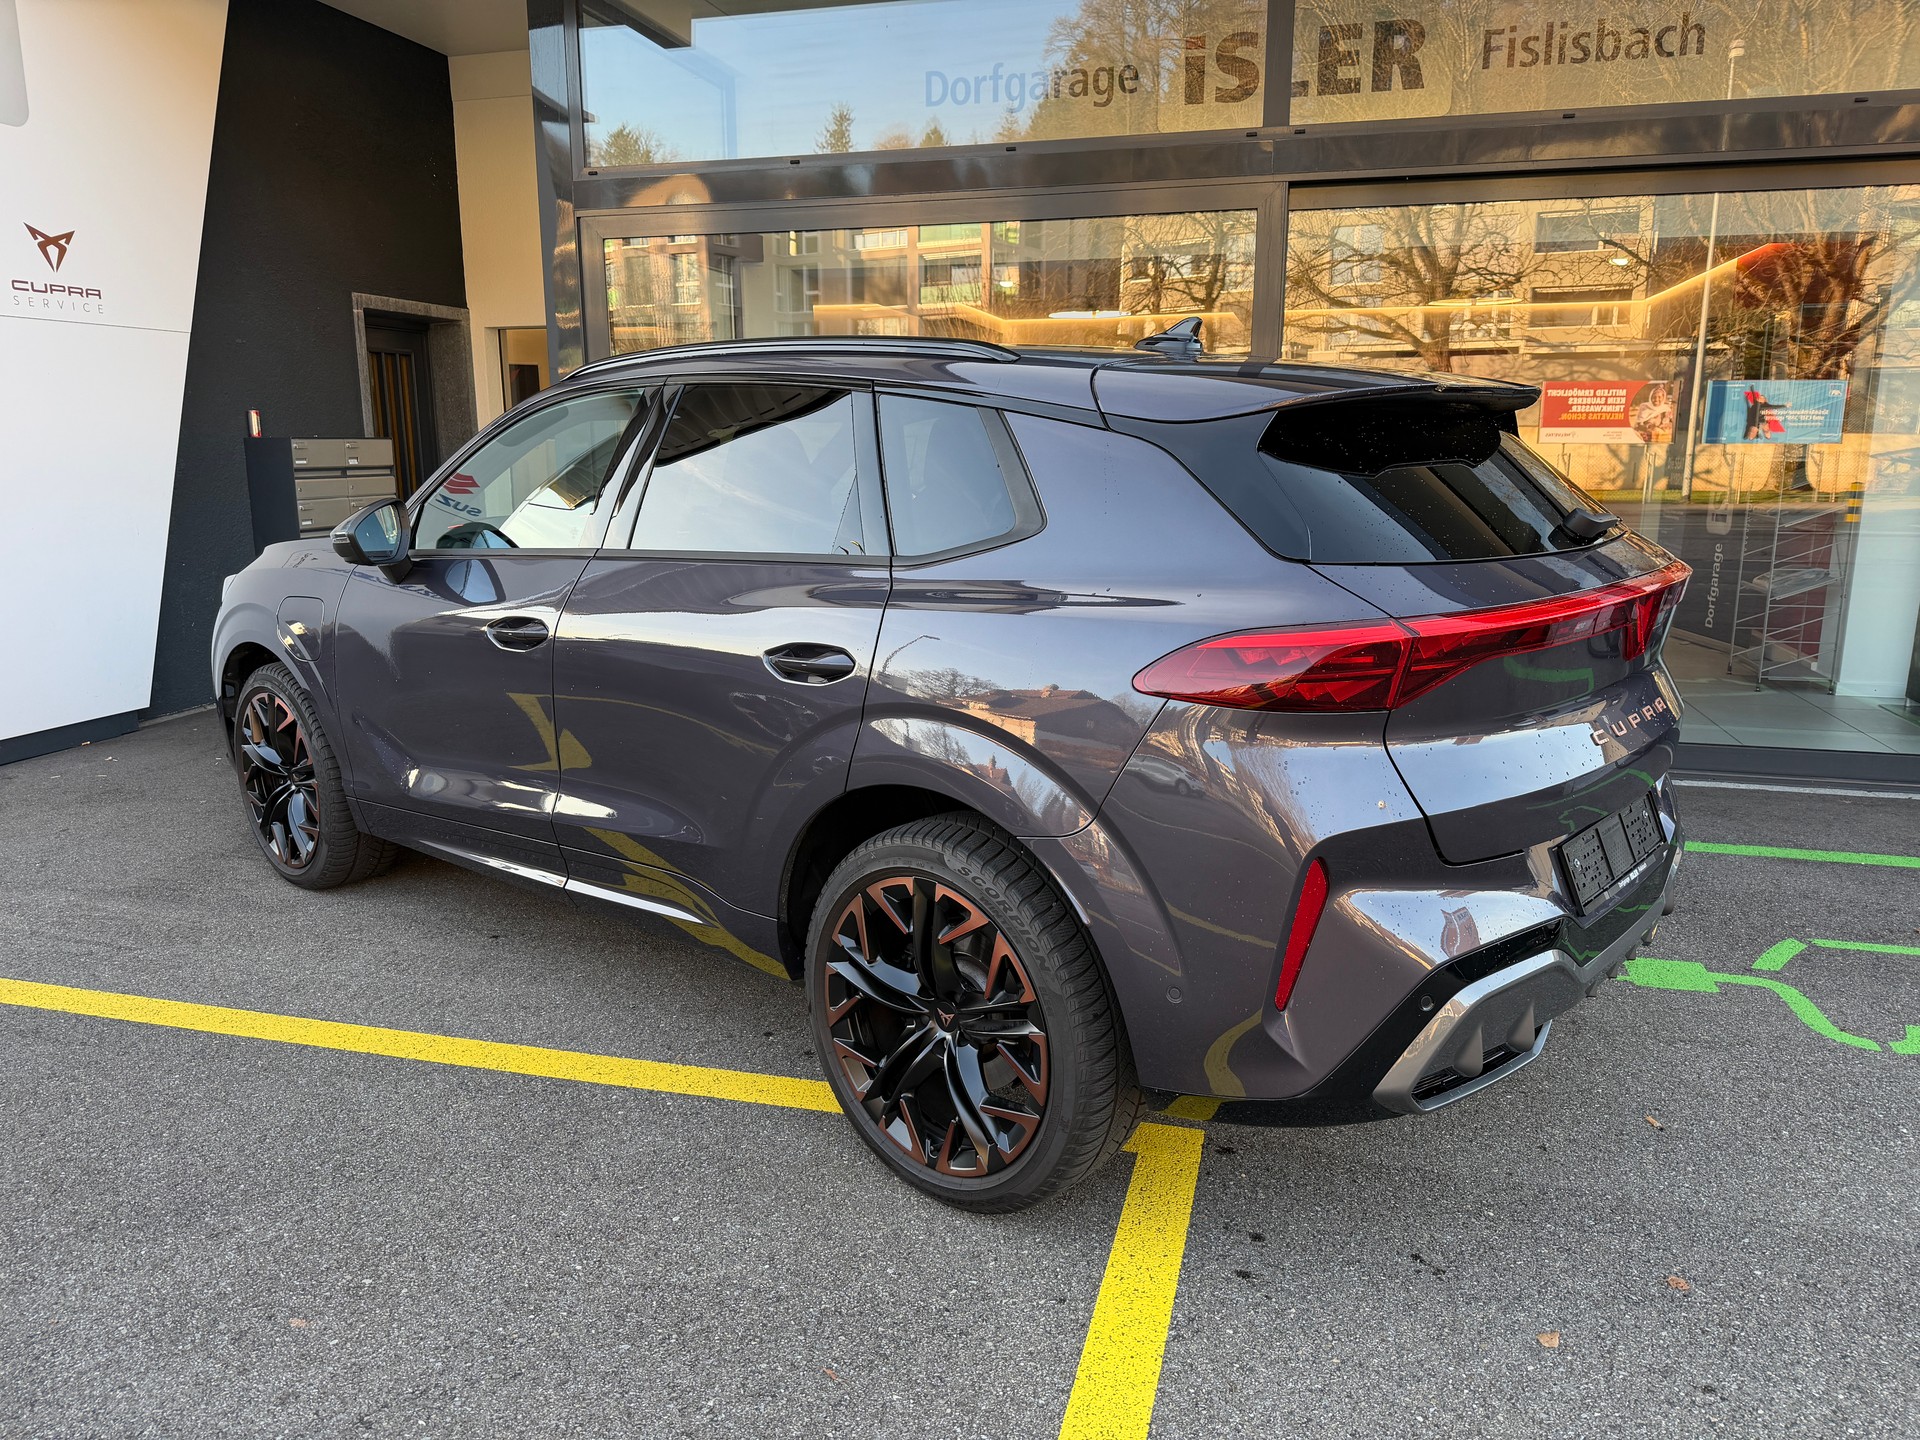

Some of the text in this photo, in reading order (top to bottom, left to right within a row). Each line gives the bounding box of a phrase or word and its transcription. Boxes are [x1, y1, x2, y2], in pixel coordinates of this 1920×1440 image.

[925, 12, 1706, 113] Dorfgarage iSER Fislisbach
[11, 279, 102, 300] CUPRA
[13, 295, 104, 314] SERVICE
[1704, 542, 1723, 629] Dorfgarage
[1593, 697, 1667, 745] CUPRA
[957, 866, 1051, 972] SCORPION
